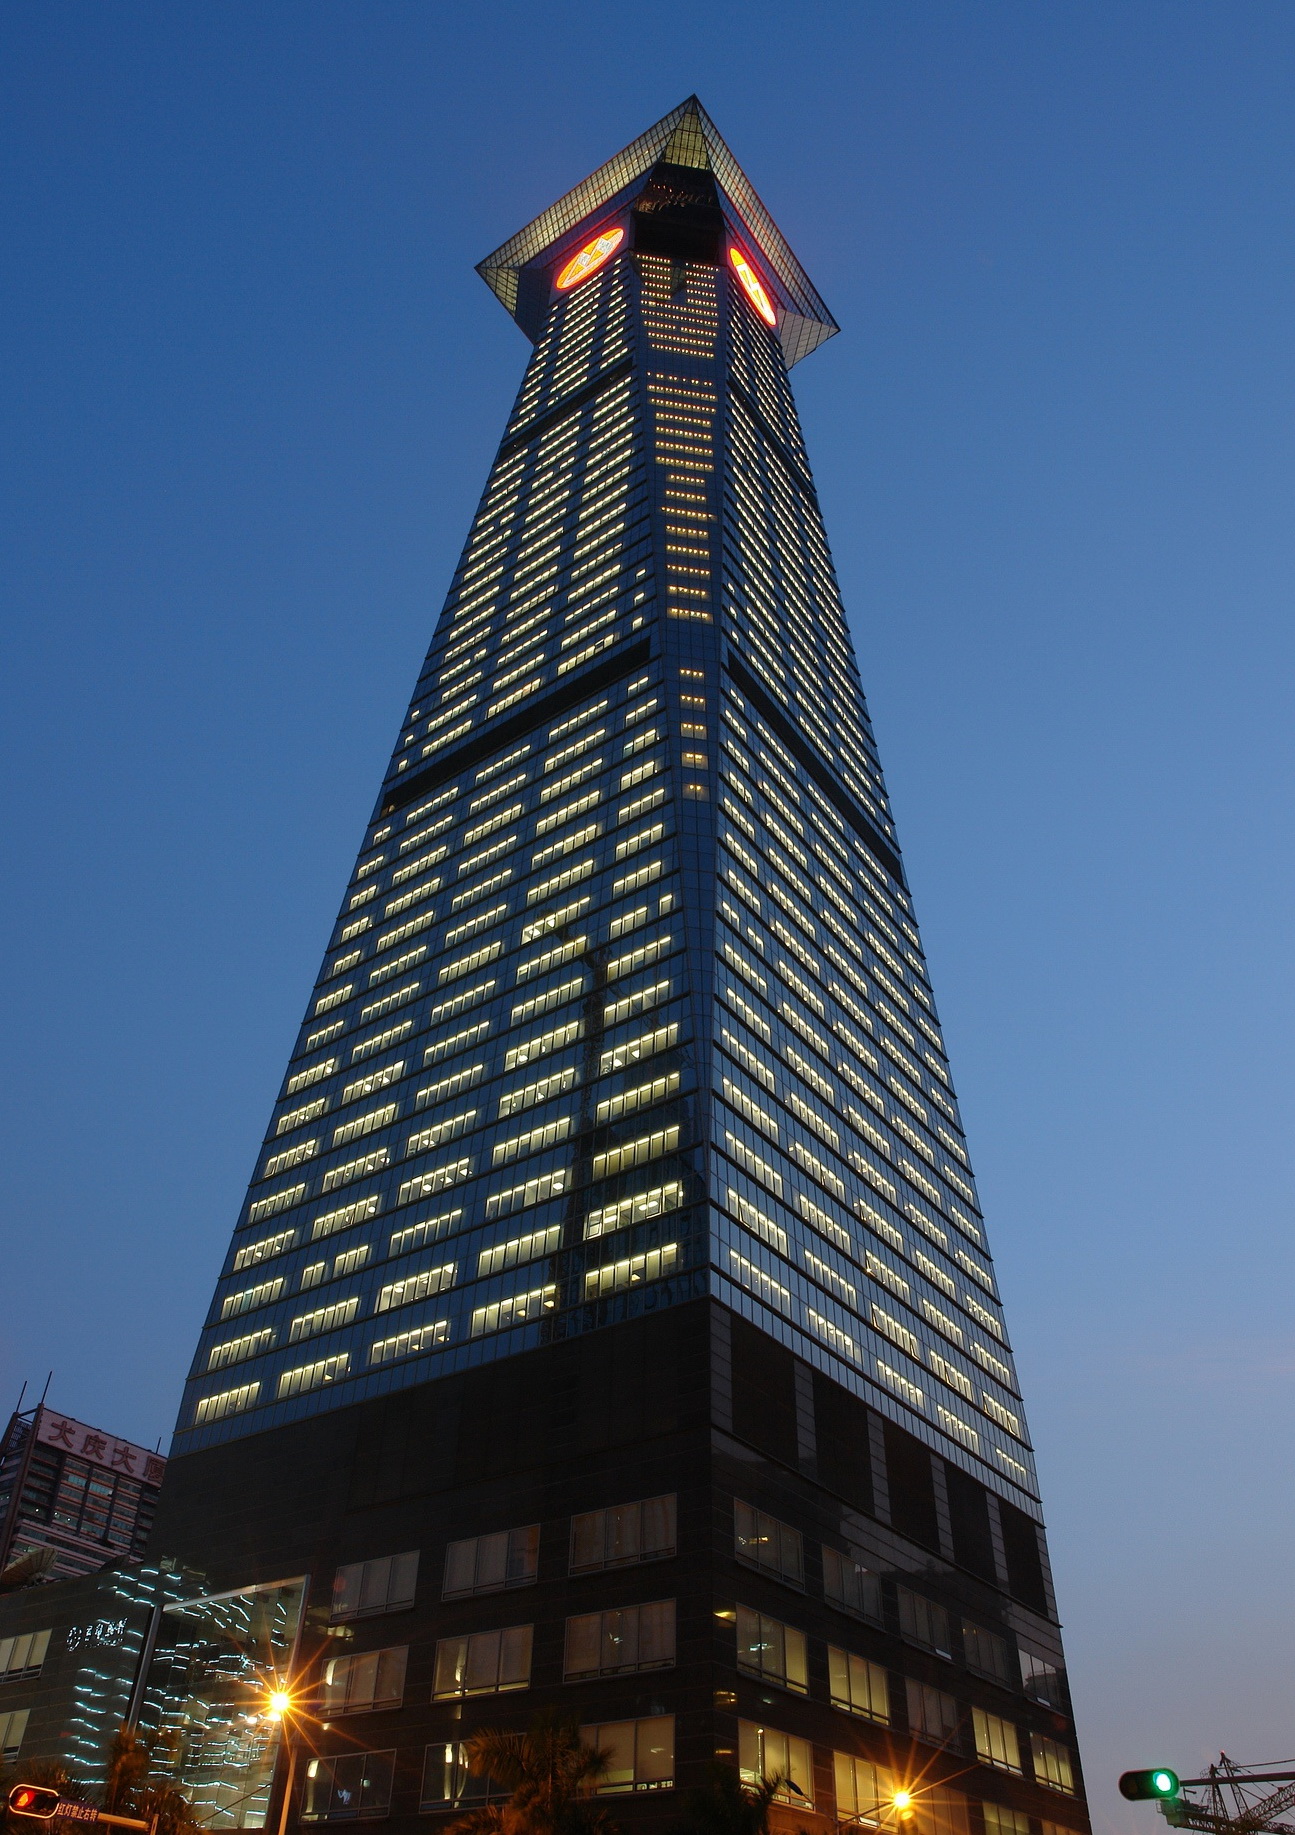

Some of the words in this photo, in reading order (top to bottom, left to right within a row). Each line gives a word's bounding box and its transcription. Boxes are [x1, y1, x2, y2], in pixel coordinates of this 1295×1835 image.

[48, 1420, 167, 1482] 大庆大厦
[57, 1802, 98, 1822] 红灯禁止右转
